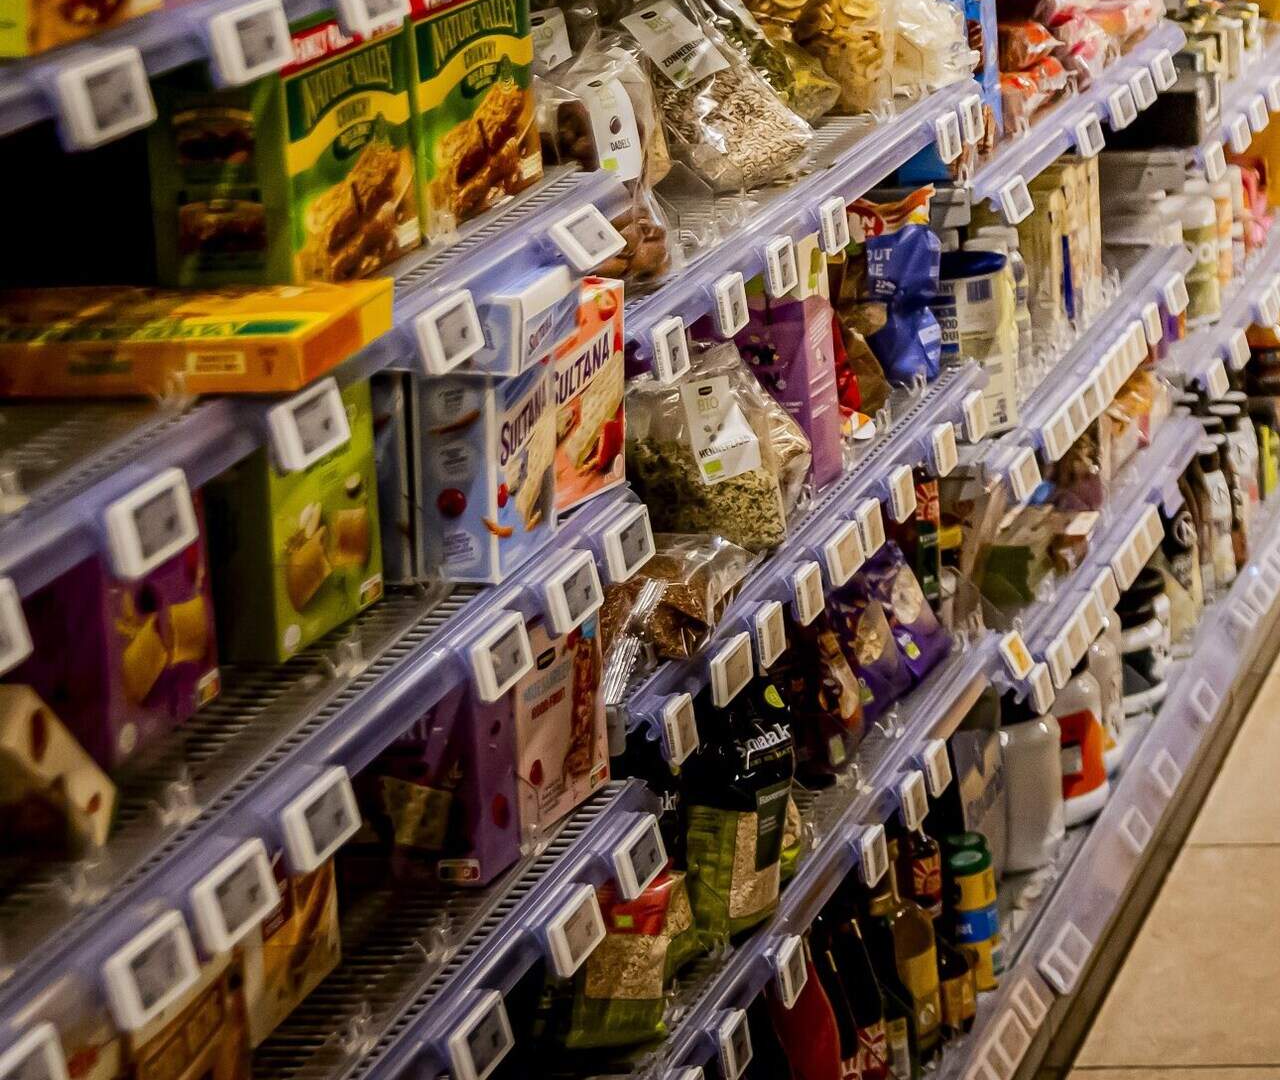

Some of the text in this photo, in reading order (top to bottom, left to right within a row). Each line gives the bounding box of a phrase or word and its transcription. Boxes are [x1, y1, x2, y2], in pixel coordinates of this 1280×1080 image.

[431, 6, 478, 71] NATURE
[553, 332, 610, 406] SULTANA
[500, 375, 547, 467] SULTANA
